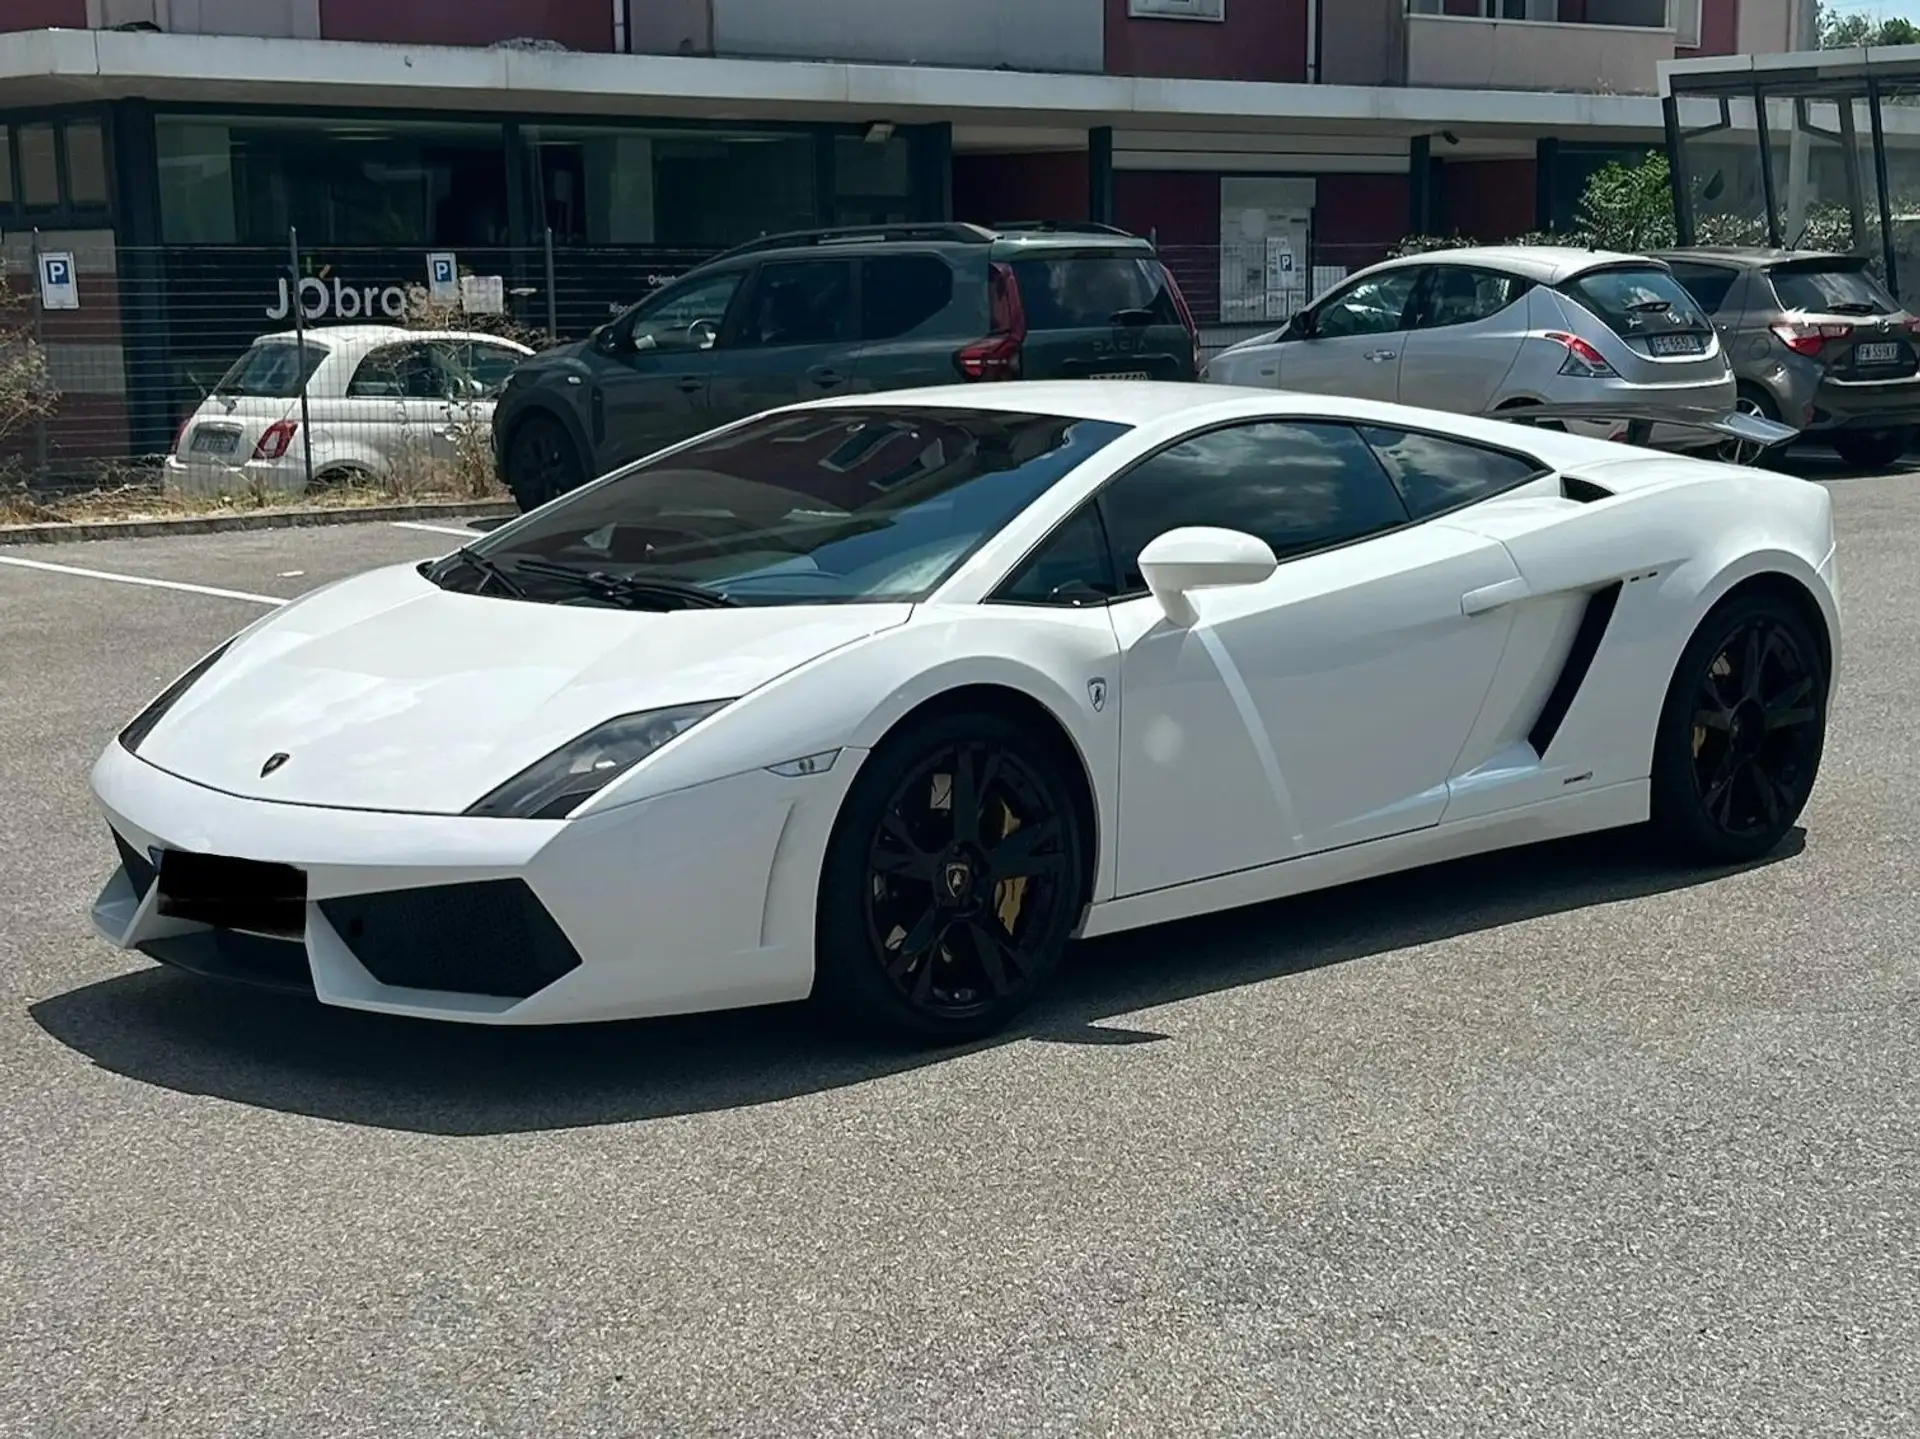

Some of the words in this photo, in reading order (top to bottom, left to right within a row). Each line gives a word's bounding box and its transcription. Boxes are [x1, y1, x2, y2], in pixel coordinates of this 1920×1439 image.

[50, 262, 65, 282] P
[436, 262, 448, 280] P
[1282, 256, 1290, 270] P
